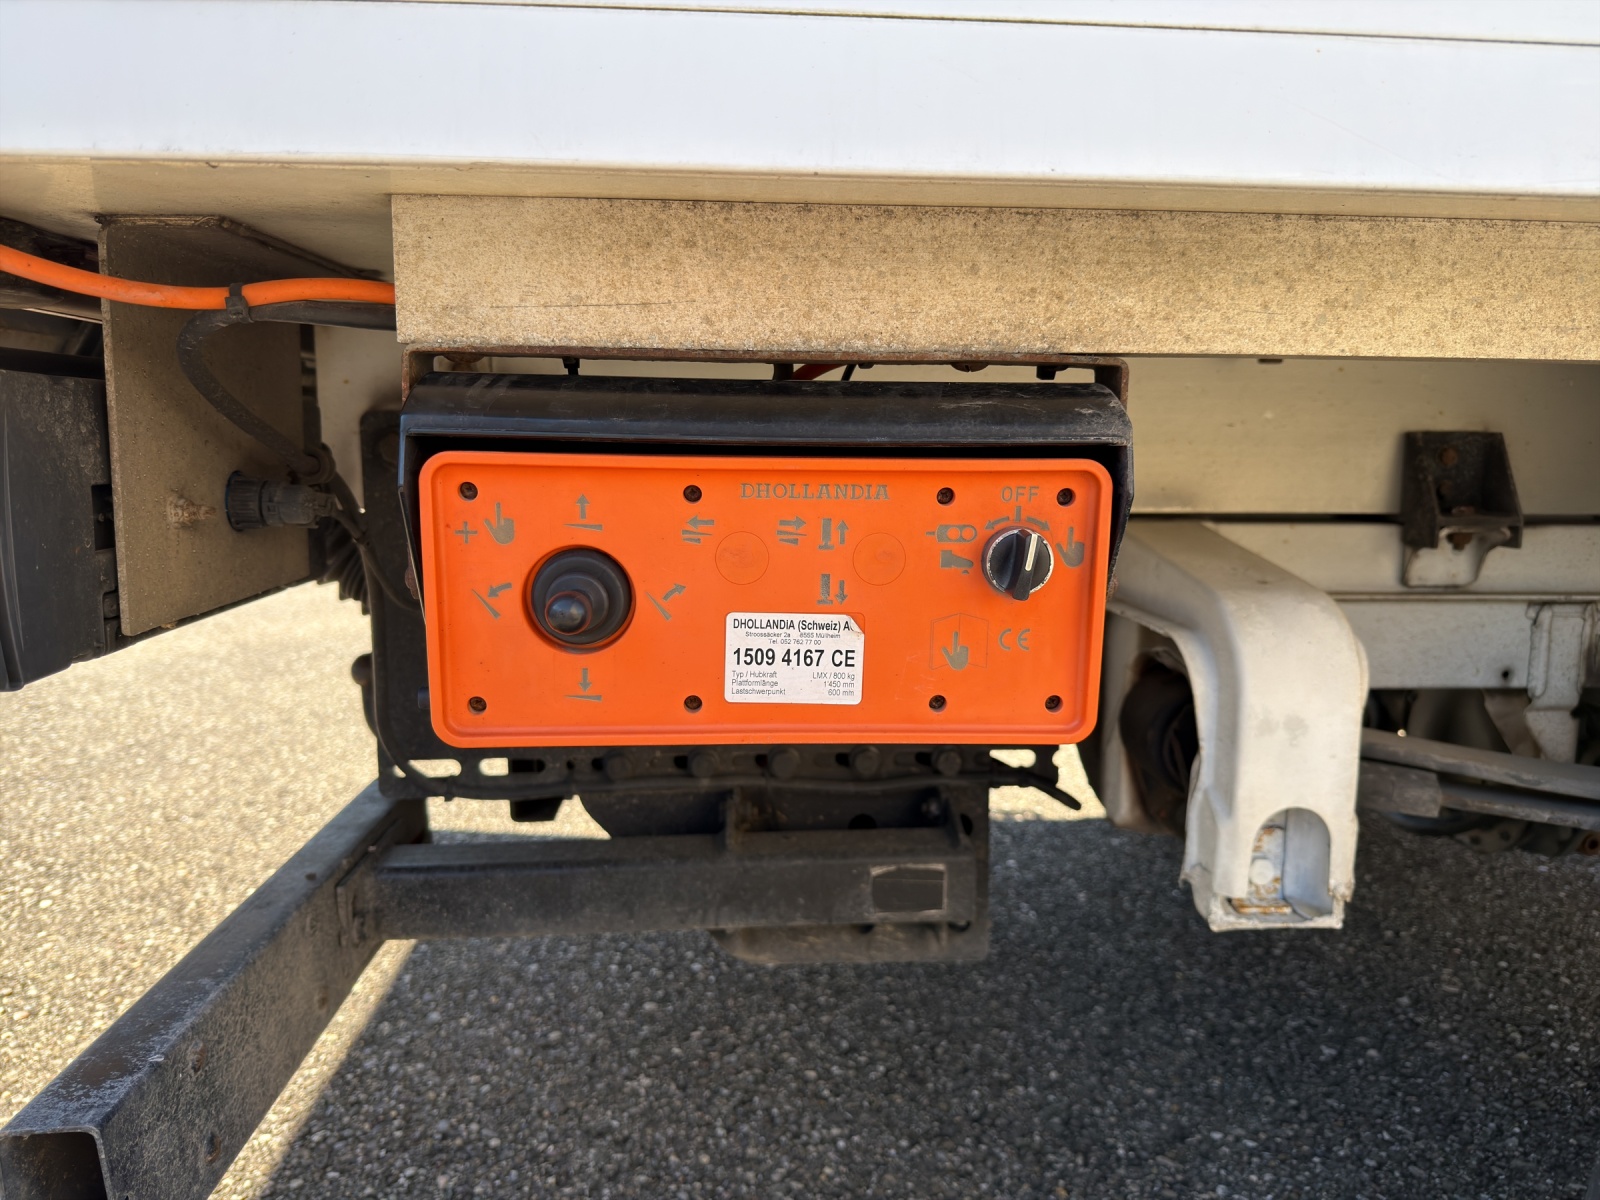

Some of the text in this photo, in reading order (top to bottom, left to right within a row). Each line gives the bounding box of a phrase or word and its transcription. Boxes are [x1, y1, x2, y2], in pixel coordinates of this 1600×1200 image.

[740, 483, 890, 500] DHOLLANDIA
[1001, 486, 1040, 502] OFF
[733, 618, 796, 630] DHOLLANDIA
[797, 619, 841, 634] (Schweiz)
[998, 627, 1031, 651] CE
[733, 647, 856, 668] 1509 4167 CE
[731, 670, 745, 680] Typ
[749, 670, 778, 679] Hubkraft
[812, 672, 828, 680] LMX
[832, 672, 846, 680] 800
[847, 672, 856, 682] kg
[731, 678, 779, 689] Plattformlänge
[731, 687, 855, 697] Lastschwerpunkt 600 mm
